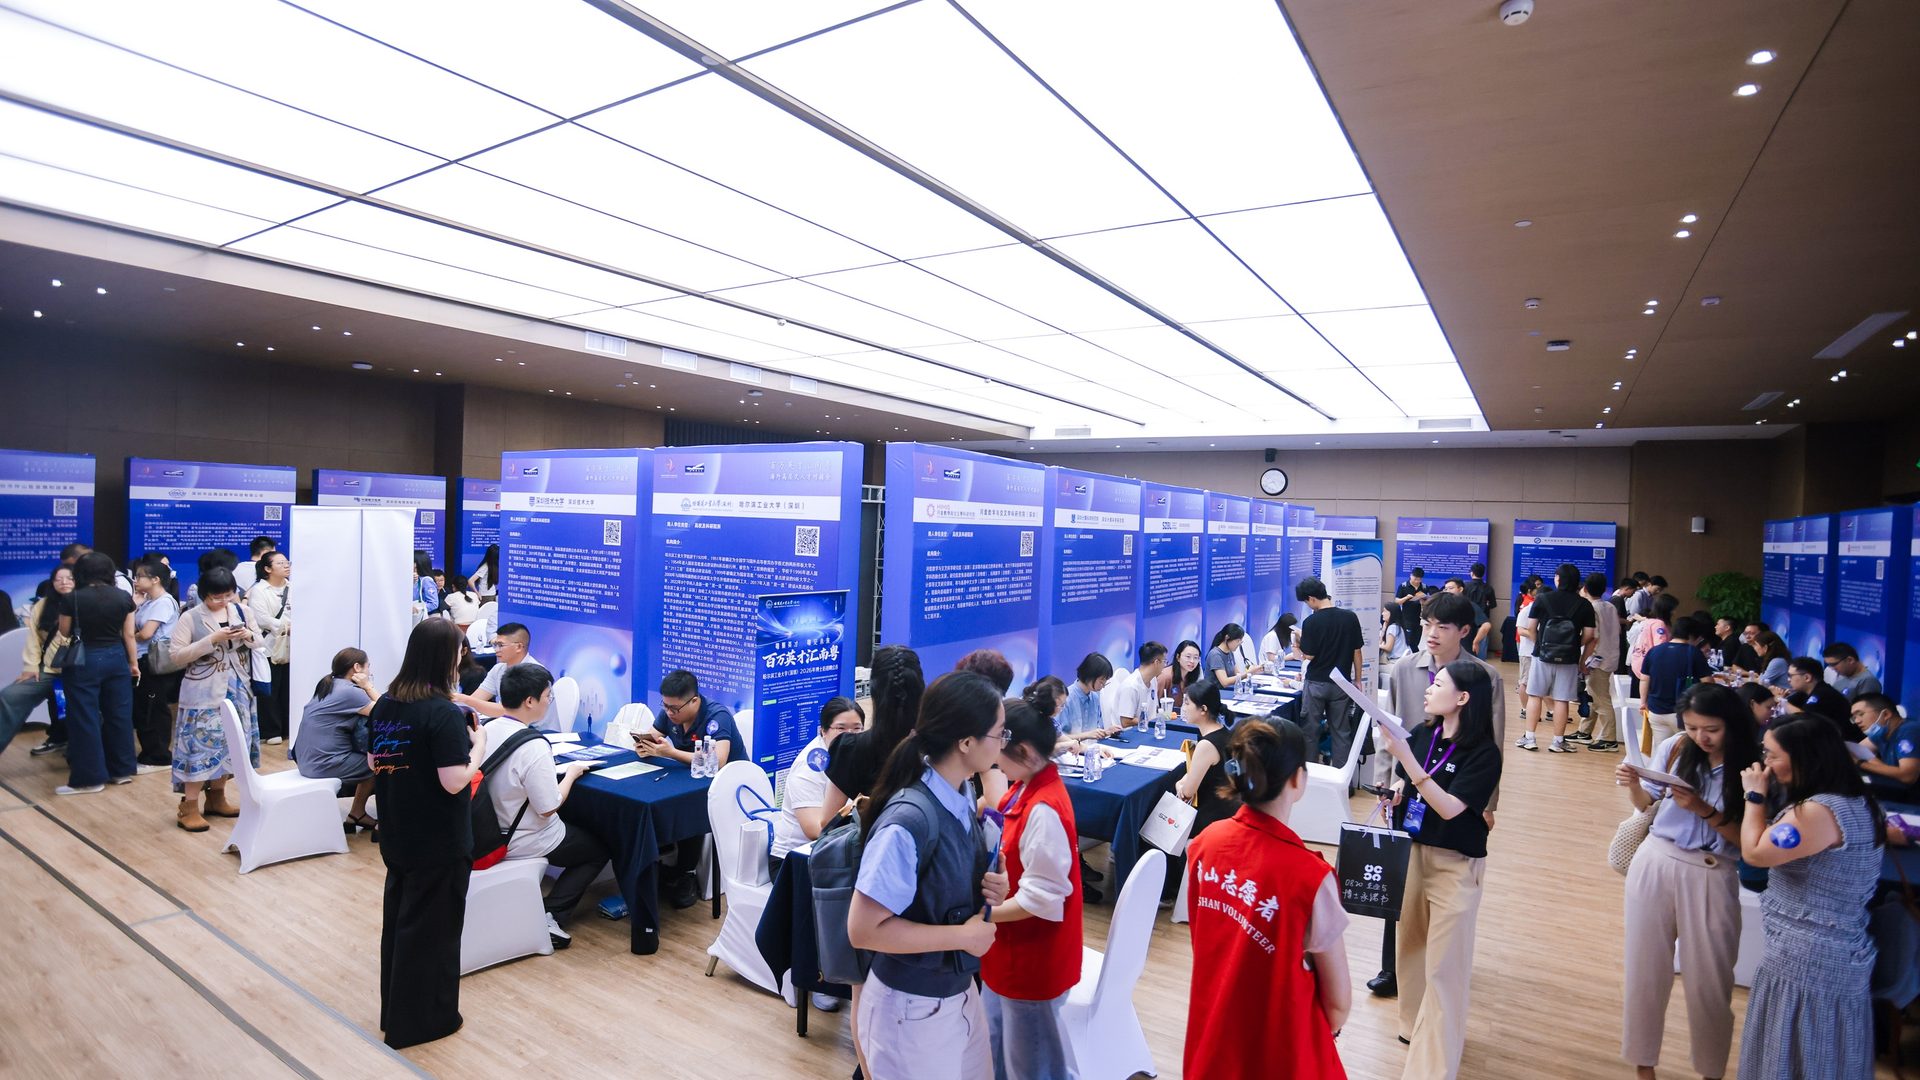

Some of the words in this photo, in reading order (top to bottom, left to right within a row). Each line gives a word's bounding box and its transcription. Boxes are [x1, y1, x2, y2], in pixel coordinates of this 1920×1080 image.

[762, 645, 840, 669] 百万英才汇南粤
[1222, 902, 1276, 954] VOLUNTEER
